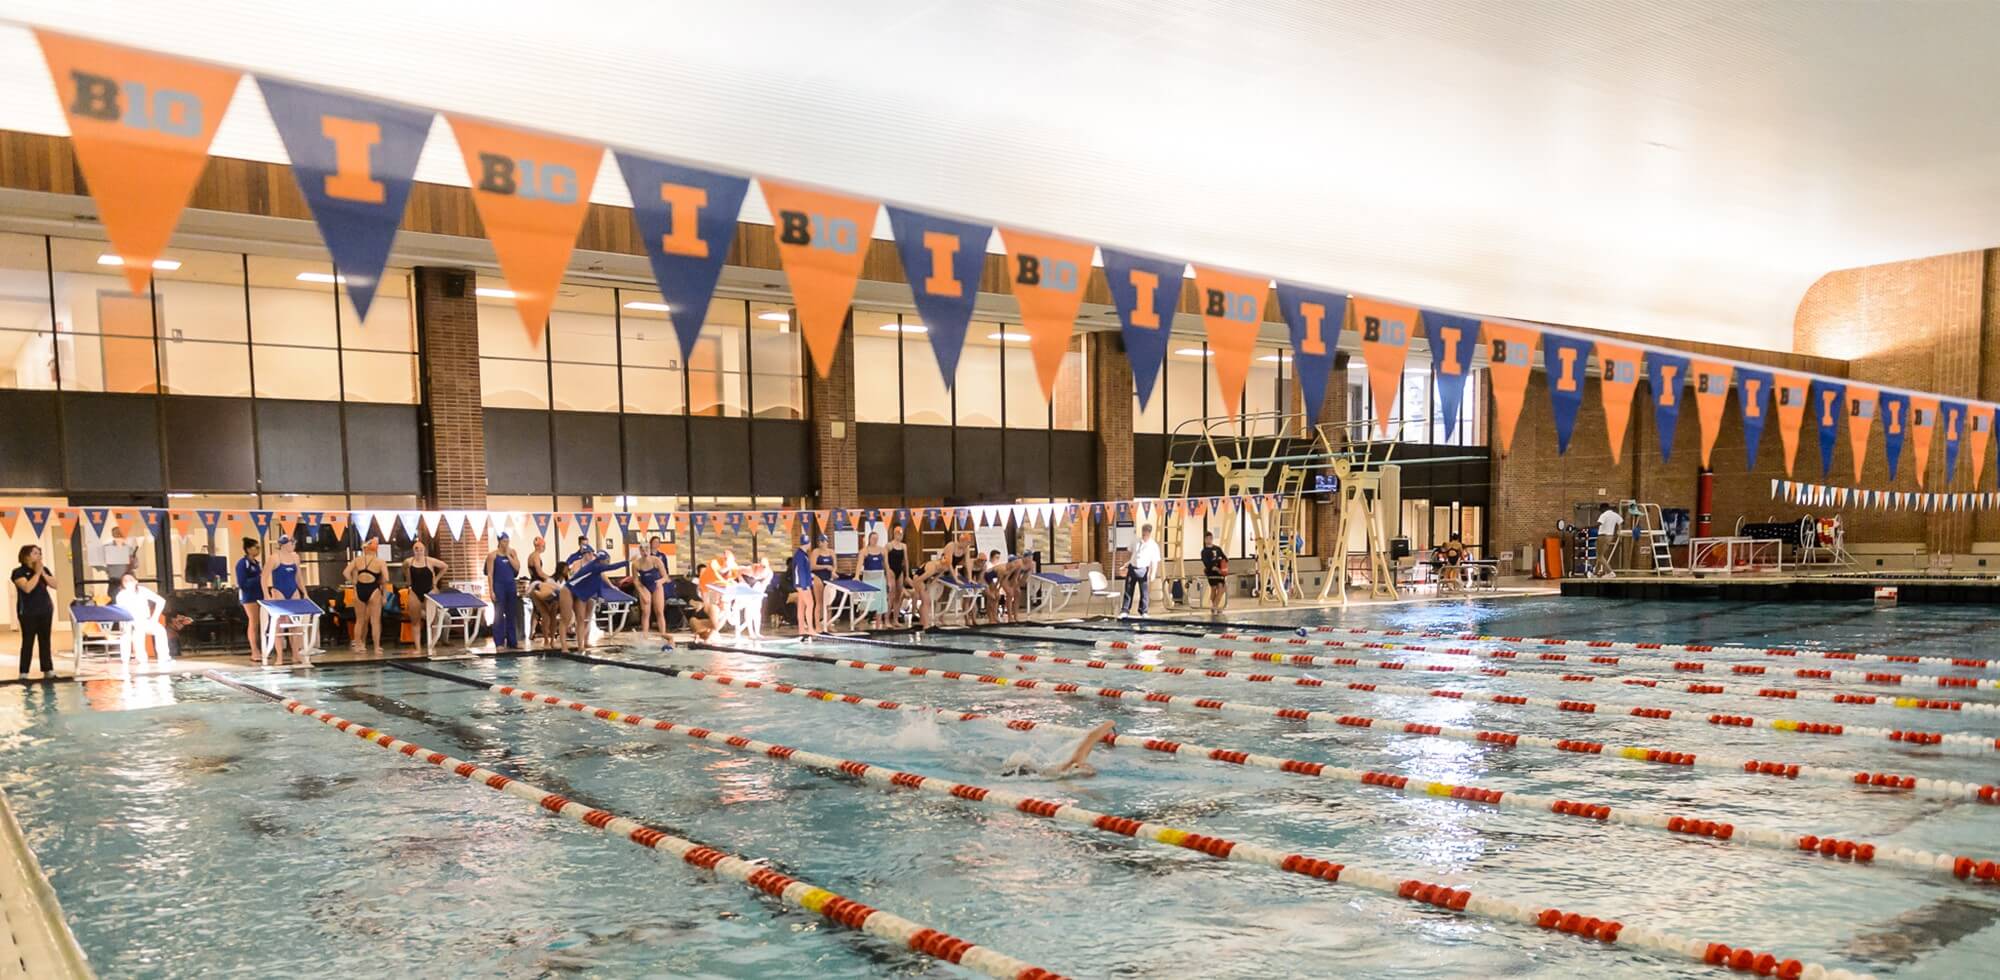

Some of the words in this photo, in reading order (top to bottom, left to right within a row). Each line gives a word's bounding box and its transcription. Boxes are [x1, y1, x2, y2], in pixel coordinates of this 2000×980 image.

[321, 115, 386, 204] I
[661, 183, 709, 257] I
[923, 232, 963, 297] I
[1130, 271, 1160, 329] I
[1301, 303, 1326, 355] I
[1440, 327, 1461, 375] I
[1557, 347, 1577, 392] I
[1659, 365, 1677, 406] I
